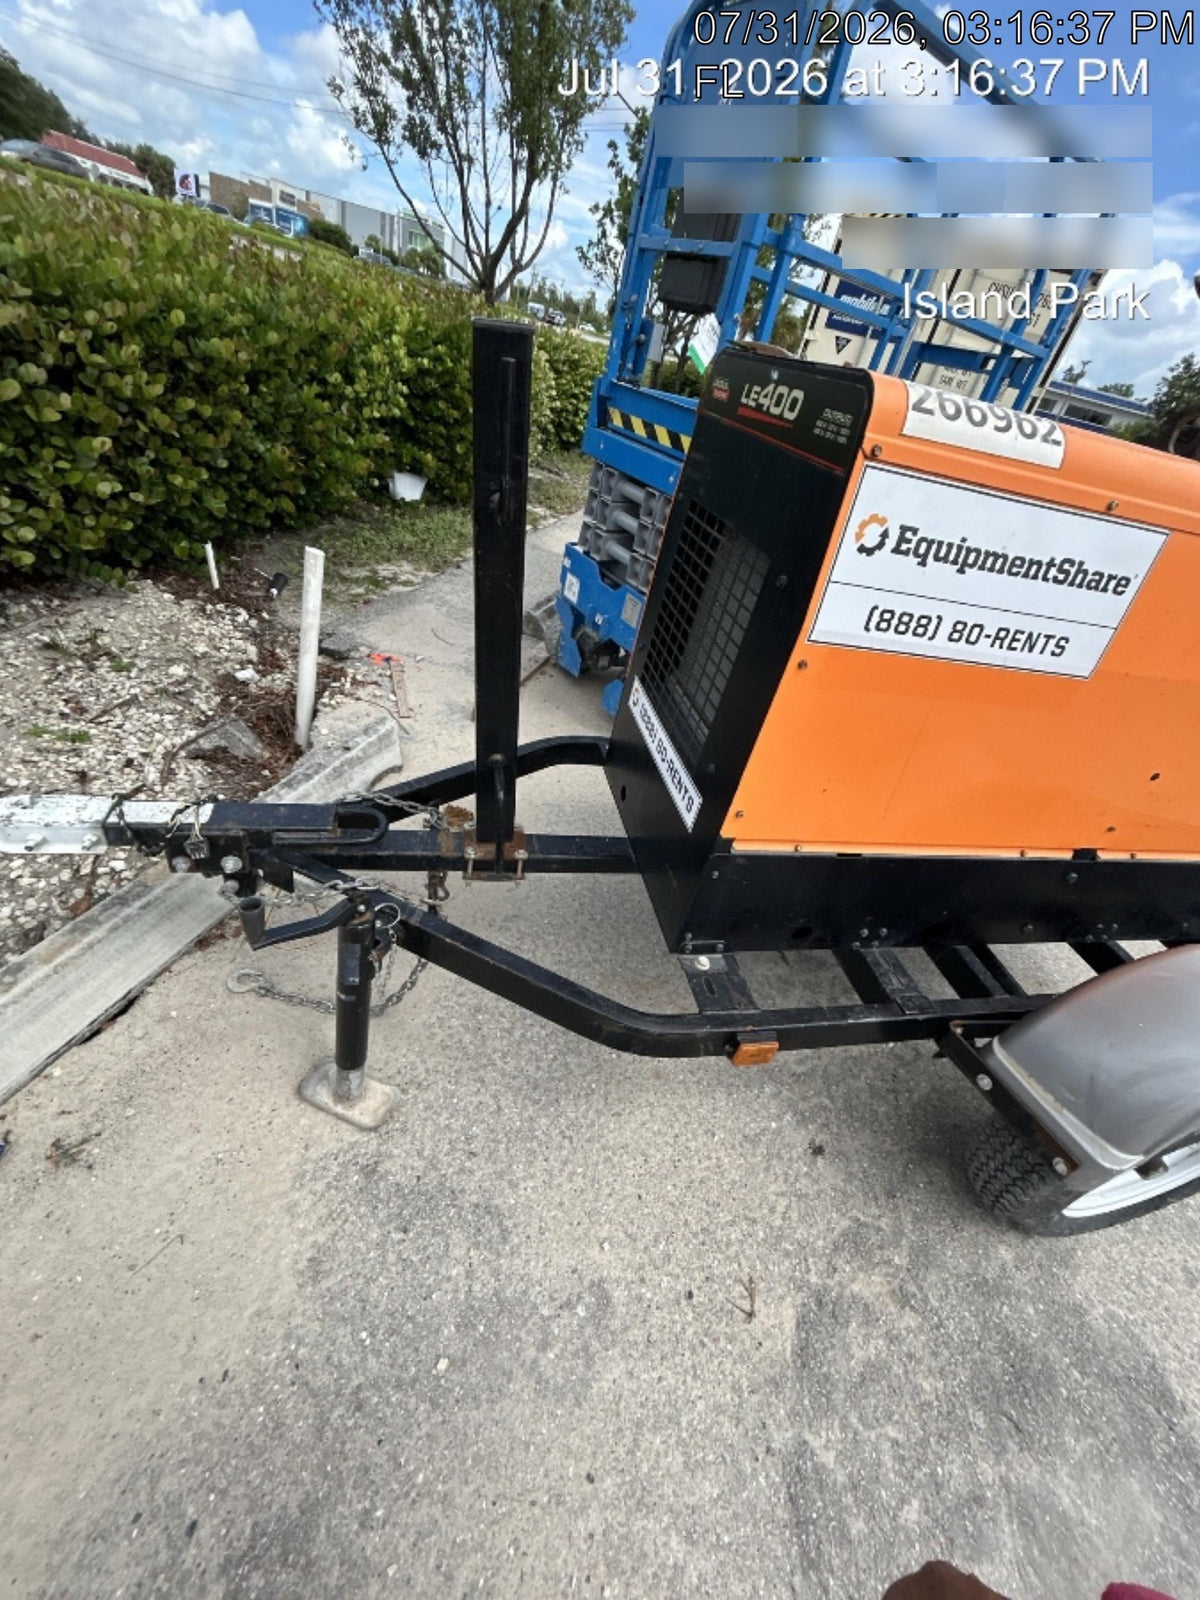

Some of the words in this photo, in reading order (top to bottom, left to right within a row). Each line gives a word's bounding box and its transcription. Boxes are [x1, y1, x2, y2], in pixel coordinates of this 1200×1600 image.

[740, 383, 805, 421] LE400
[911, 387, 1063, 446] 266962
[890, 524, 1131, 597] EquipmentShare
[864, 605, 943, 641] (888)
[947, 622, 1070, 658] 80-RENTS
